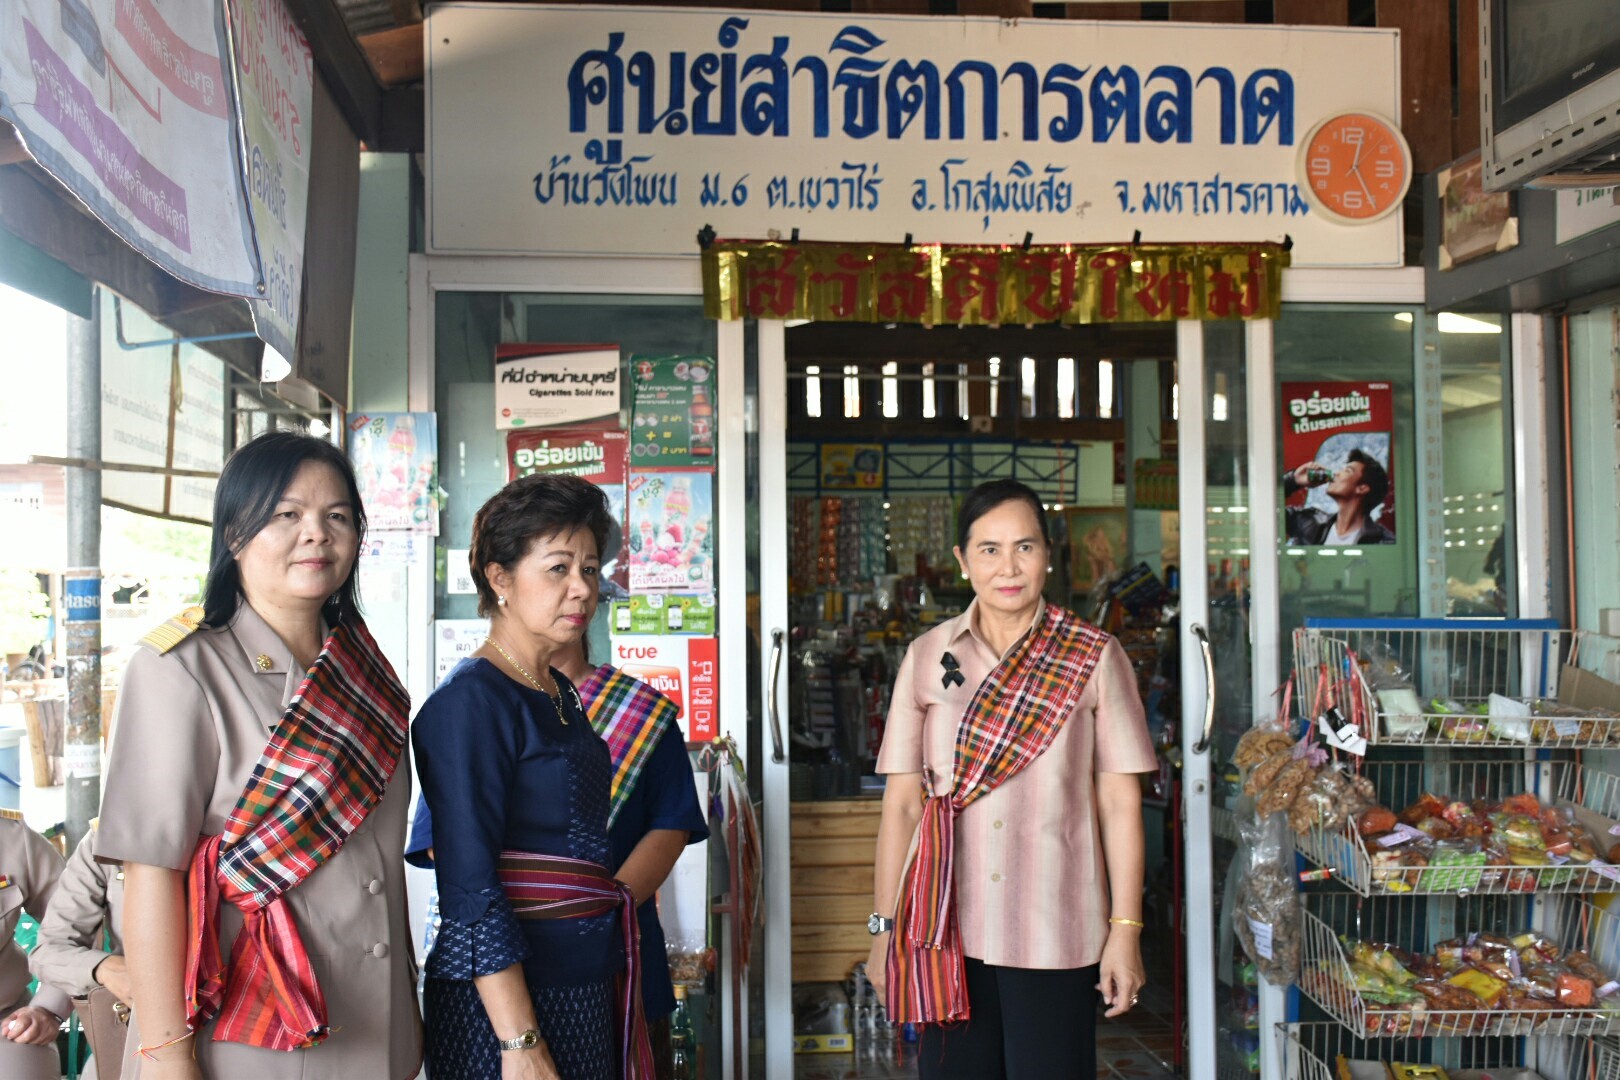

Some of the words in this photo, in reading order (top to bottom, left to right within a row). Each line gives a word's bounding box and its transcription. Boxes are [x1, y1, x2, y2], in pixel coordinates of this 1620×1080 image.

[1572, 62, 1596, 80] SHARP
[568, 17, 1294, 165] ศูนย์สาธิตการตลาด
[1312, 158, 1330, 175] 9
[1376, 160, 1394, 177] 3
[533, 154, 678, 206] บ้านวังโพน
[912, 158, 1072, 232] อ.โกสุมพิสัย
[1114, 172, 1310, 217] จ.มหาสารคาม
[1344, 191, 1362, 208] 6
[529, 388, 572, 398] Cigarettes
[575, 388, 593, 396] Sold
[595, 388, 614, 396] Here
[1290, 390, 1370, 417] อร่อยเข้ม
[516, 439, 604, 468] อร่อยเข้ม
[617, 645, 658, 659] true
